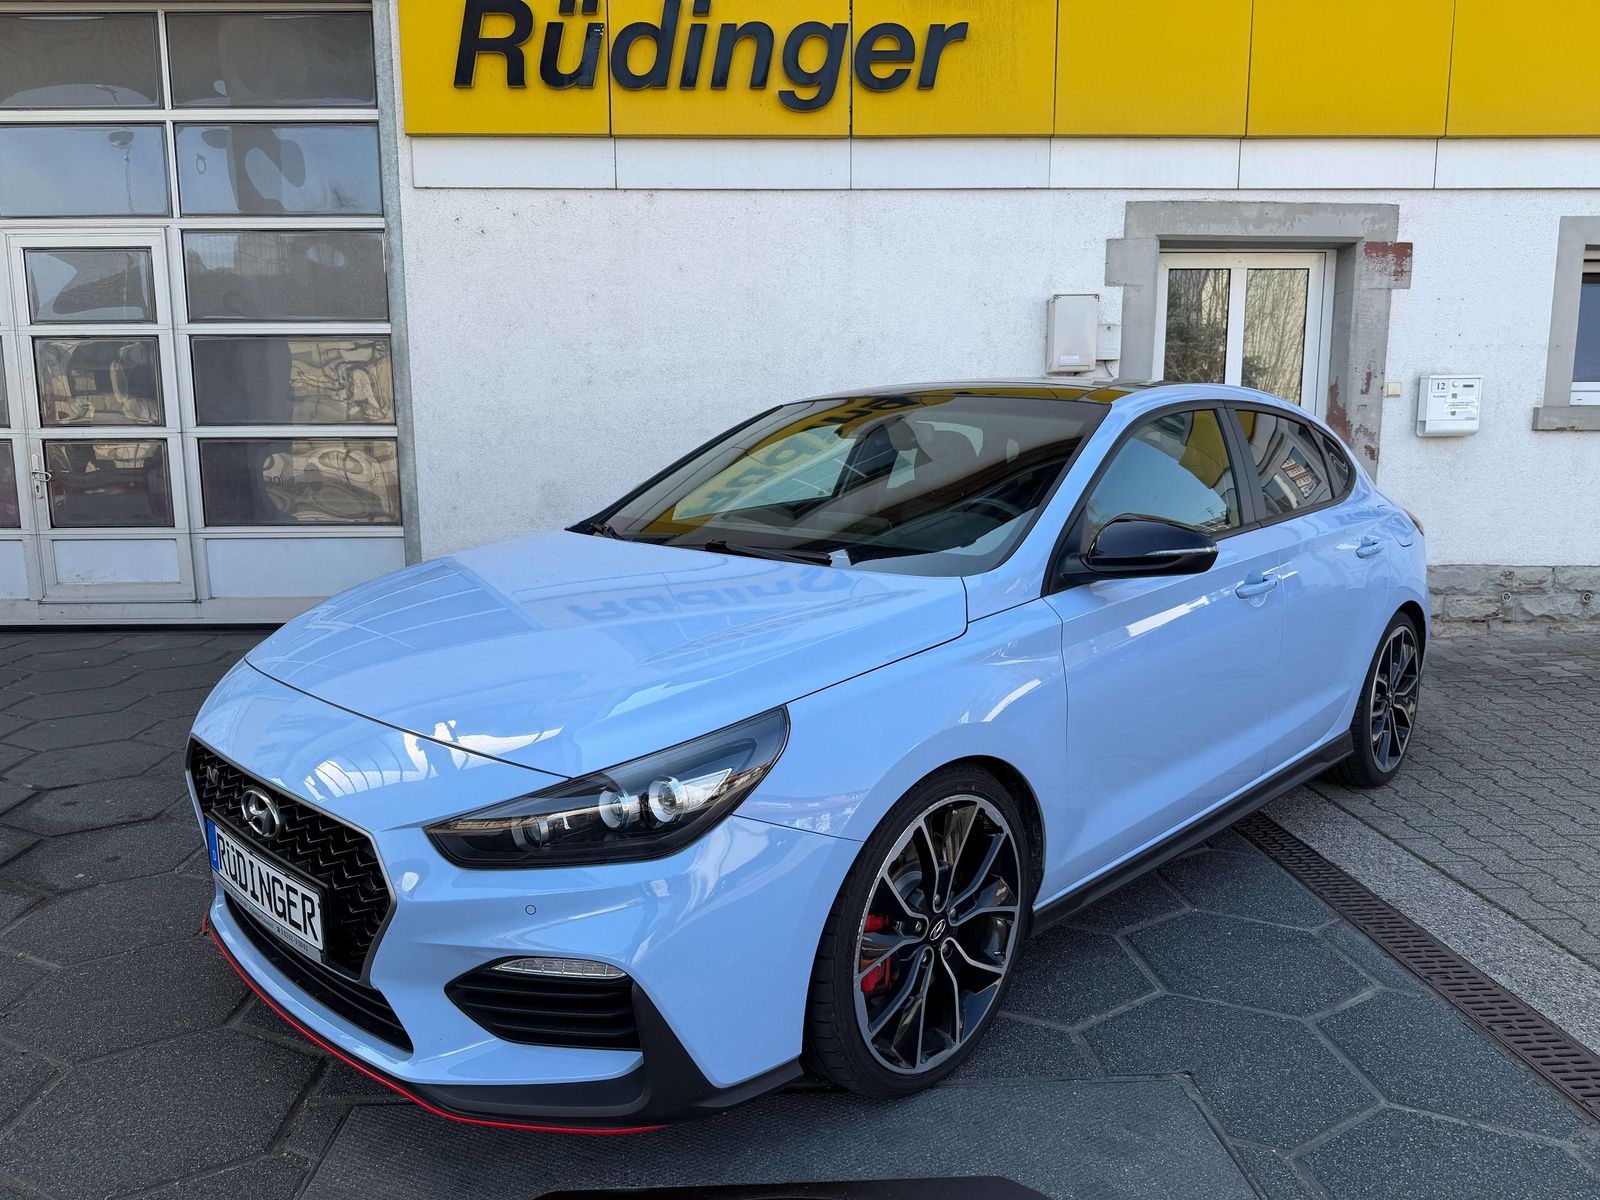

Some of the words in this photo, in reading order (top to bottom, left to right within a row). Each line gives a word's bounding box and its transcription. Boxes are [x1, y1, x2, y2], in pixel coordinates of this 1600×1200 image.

[453, 0, 969, 113] Rüdinger
[1436, 382, 1446, 390] 12
[216, 832, 319, 942] RÜDINGER
